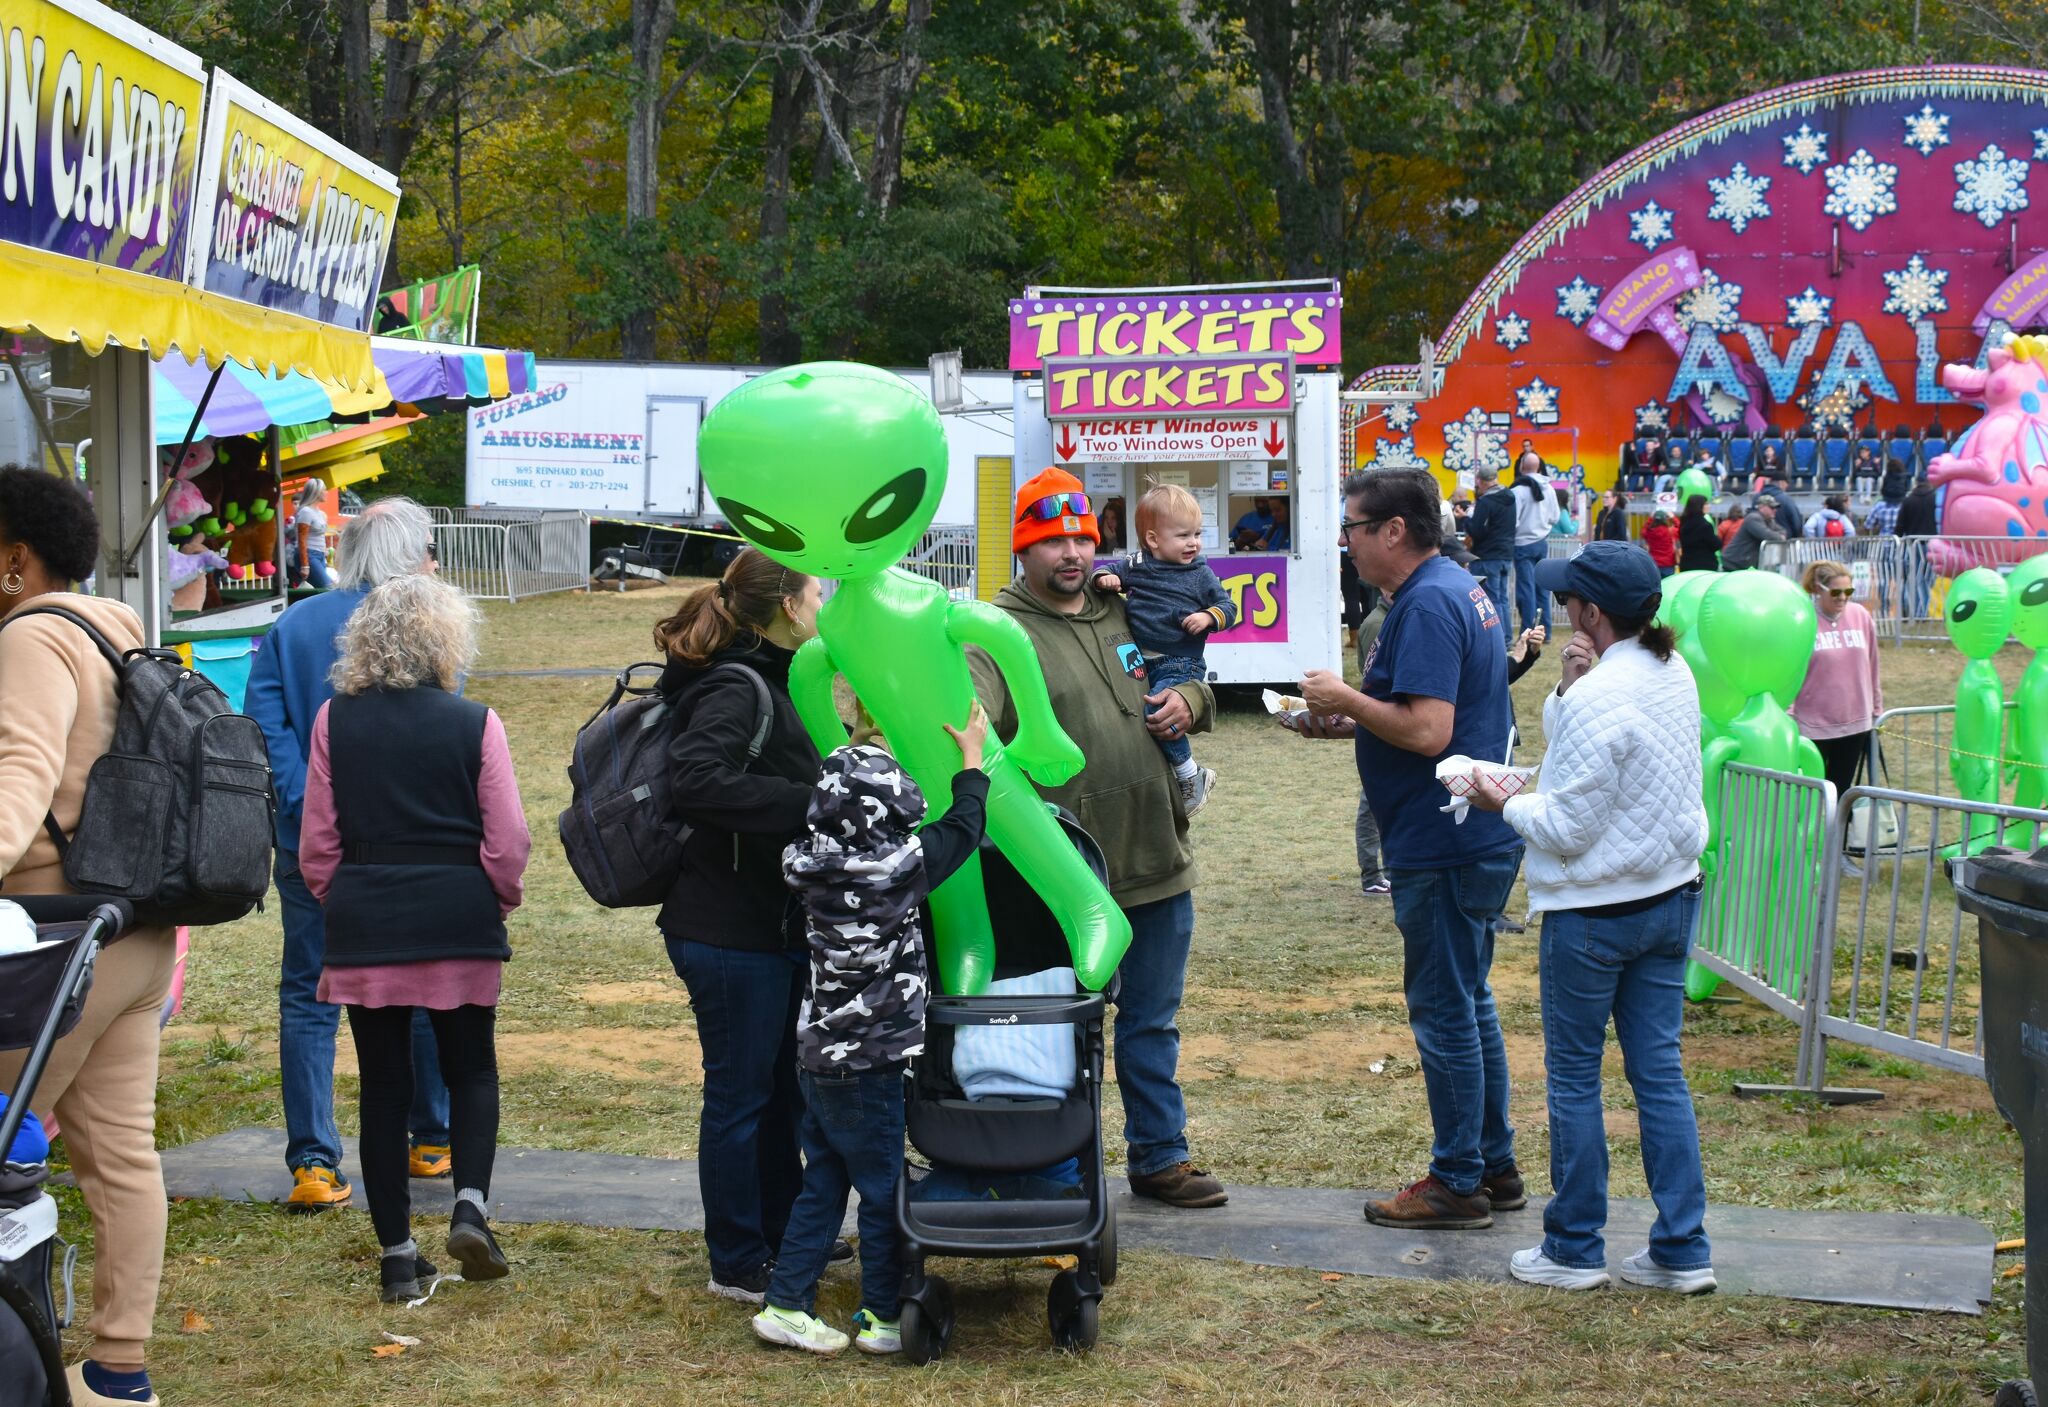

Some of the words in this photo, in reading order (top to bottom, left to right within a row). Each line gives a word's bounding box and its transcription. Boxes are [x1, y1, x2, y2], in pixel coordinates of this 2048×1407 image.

[51, 50, 186, 247] CANDY
[227, 130, 304, 224] CARAMEL
[215, 199, 239, 266] OR
[242, 212, 297, 285] CANDY
[292, 176, 385, 311] APPLES
[1606, 263, 1669, 317] TUFANO
[1619, 277, 1675, 327] AMUSEMENT
[1026, 307, 1326, 358] TICKETS
[1052, 362, 1286, 409] TICKETS
[474, 383, 568, 429] TUFANO
[481, 430, 643, 451] AMUSEMENT
[1077, 419, 1158, 436] TICKET
[1164, 418, 1259, 434] Windows
[1083, 438, 1118, 452] Two
[1123, 437, 1204, 452] Windows
[1211, 434, 1257, 451] Open
[515, 466, 533, 475] 1695
[536, 466, 577, 476] REINHARD
[581, 467, 605, 477] ROAD
[613, 453, 642, 465] INC.
[1092, 453, 1123, 462] Please
[1125, 452, 1149, 462] have
[1154, 453, 1175, 462] your
[1178, 451, 1219, 461] payment
[1224, 450, 1253, 460] ready
[540, 479, 552, 488] CT
[1133, 667, 1145, 679] NH
